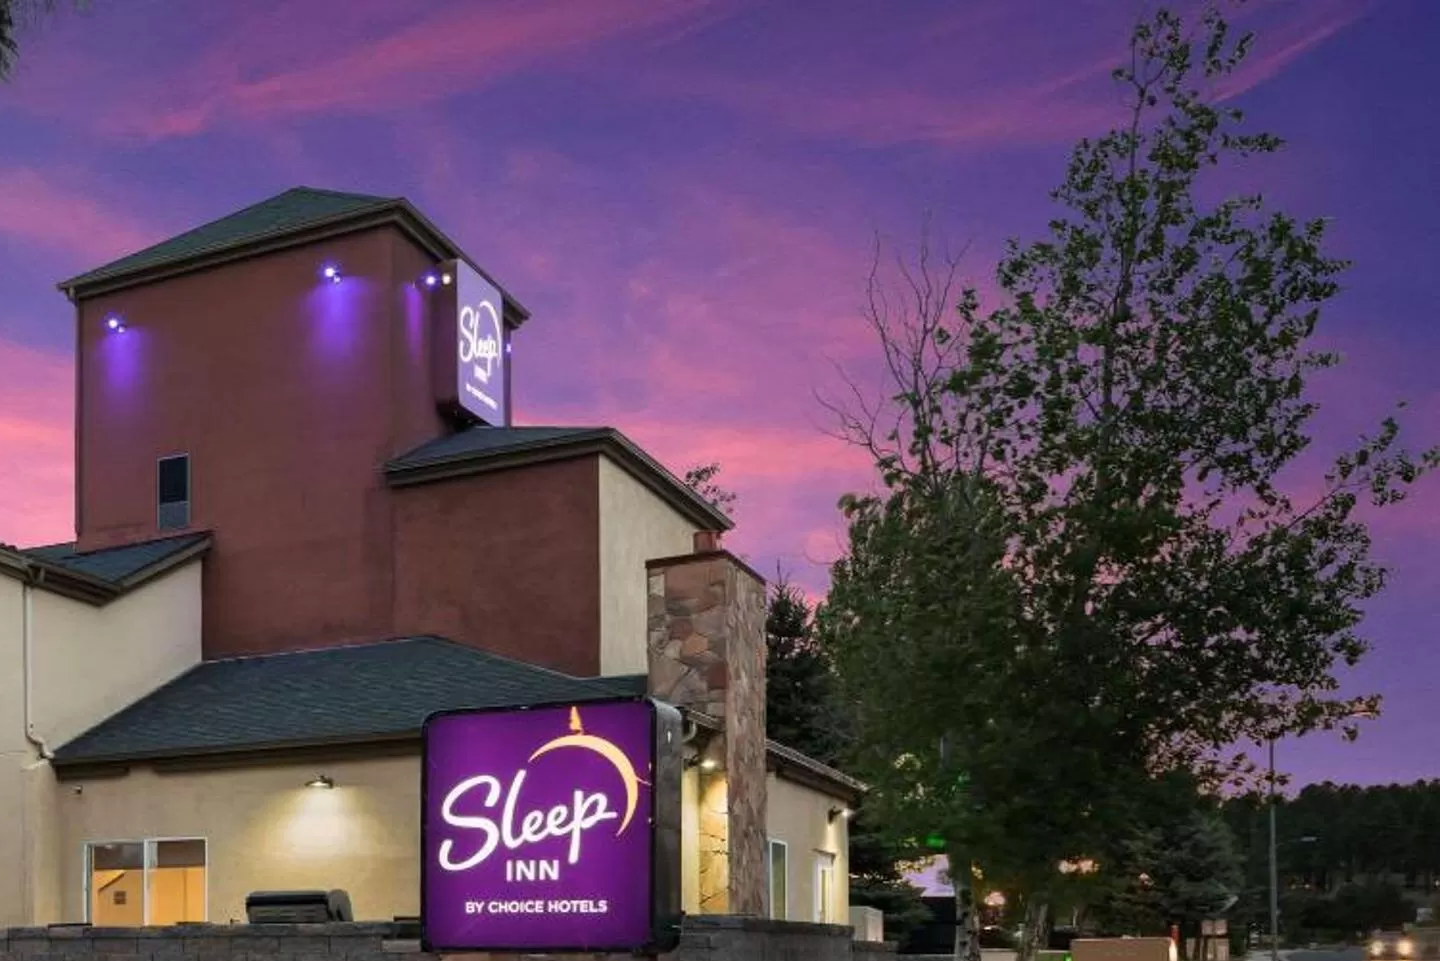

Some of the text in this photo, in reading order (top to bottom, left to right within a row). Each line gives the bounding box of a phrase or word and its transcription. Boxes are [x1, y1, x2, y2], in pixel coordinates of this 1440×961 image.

[439, 769, 617, 871] Sleep
[506, 859, 559, 882] INN
[465, 900, 608, 913] BY CHOICE HOTELS
